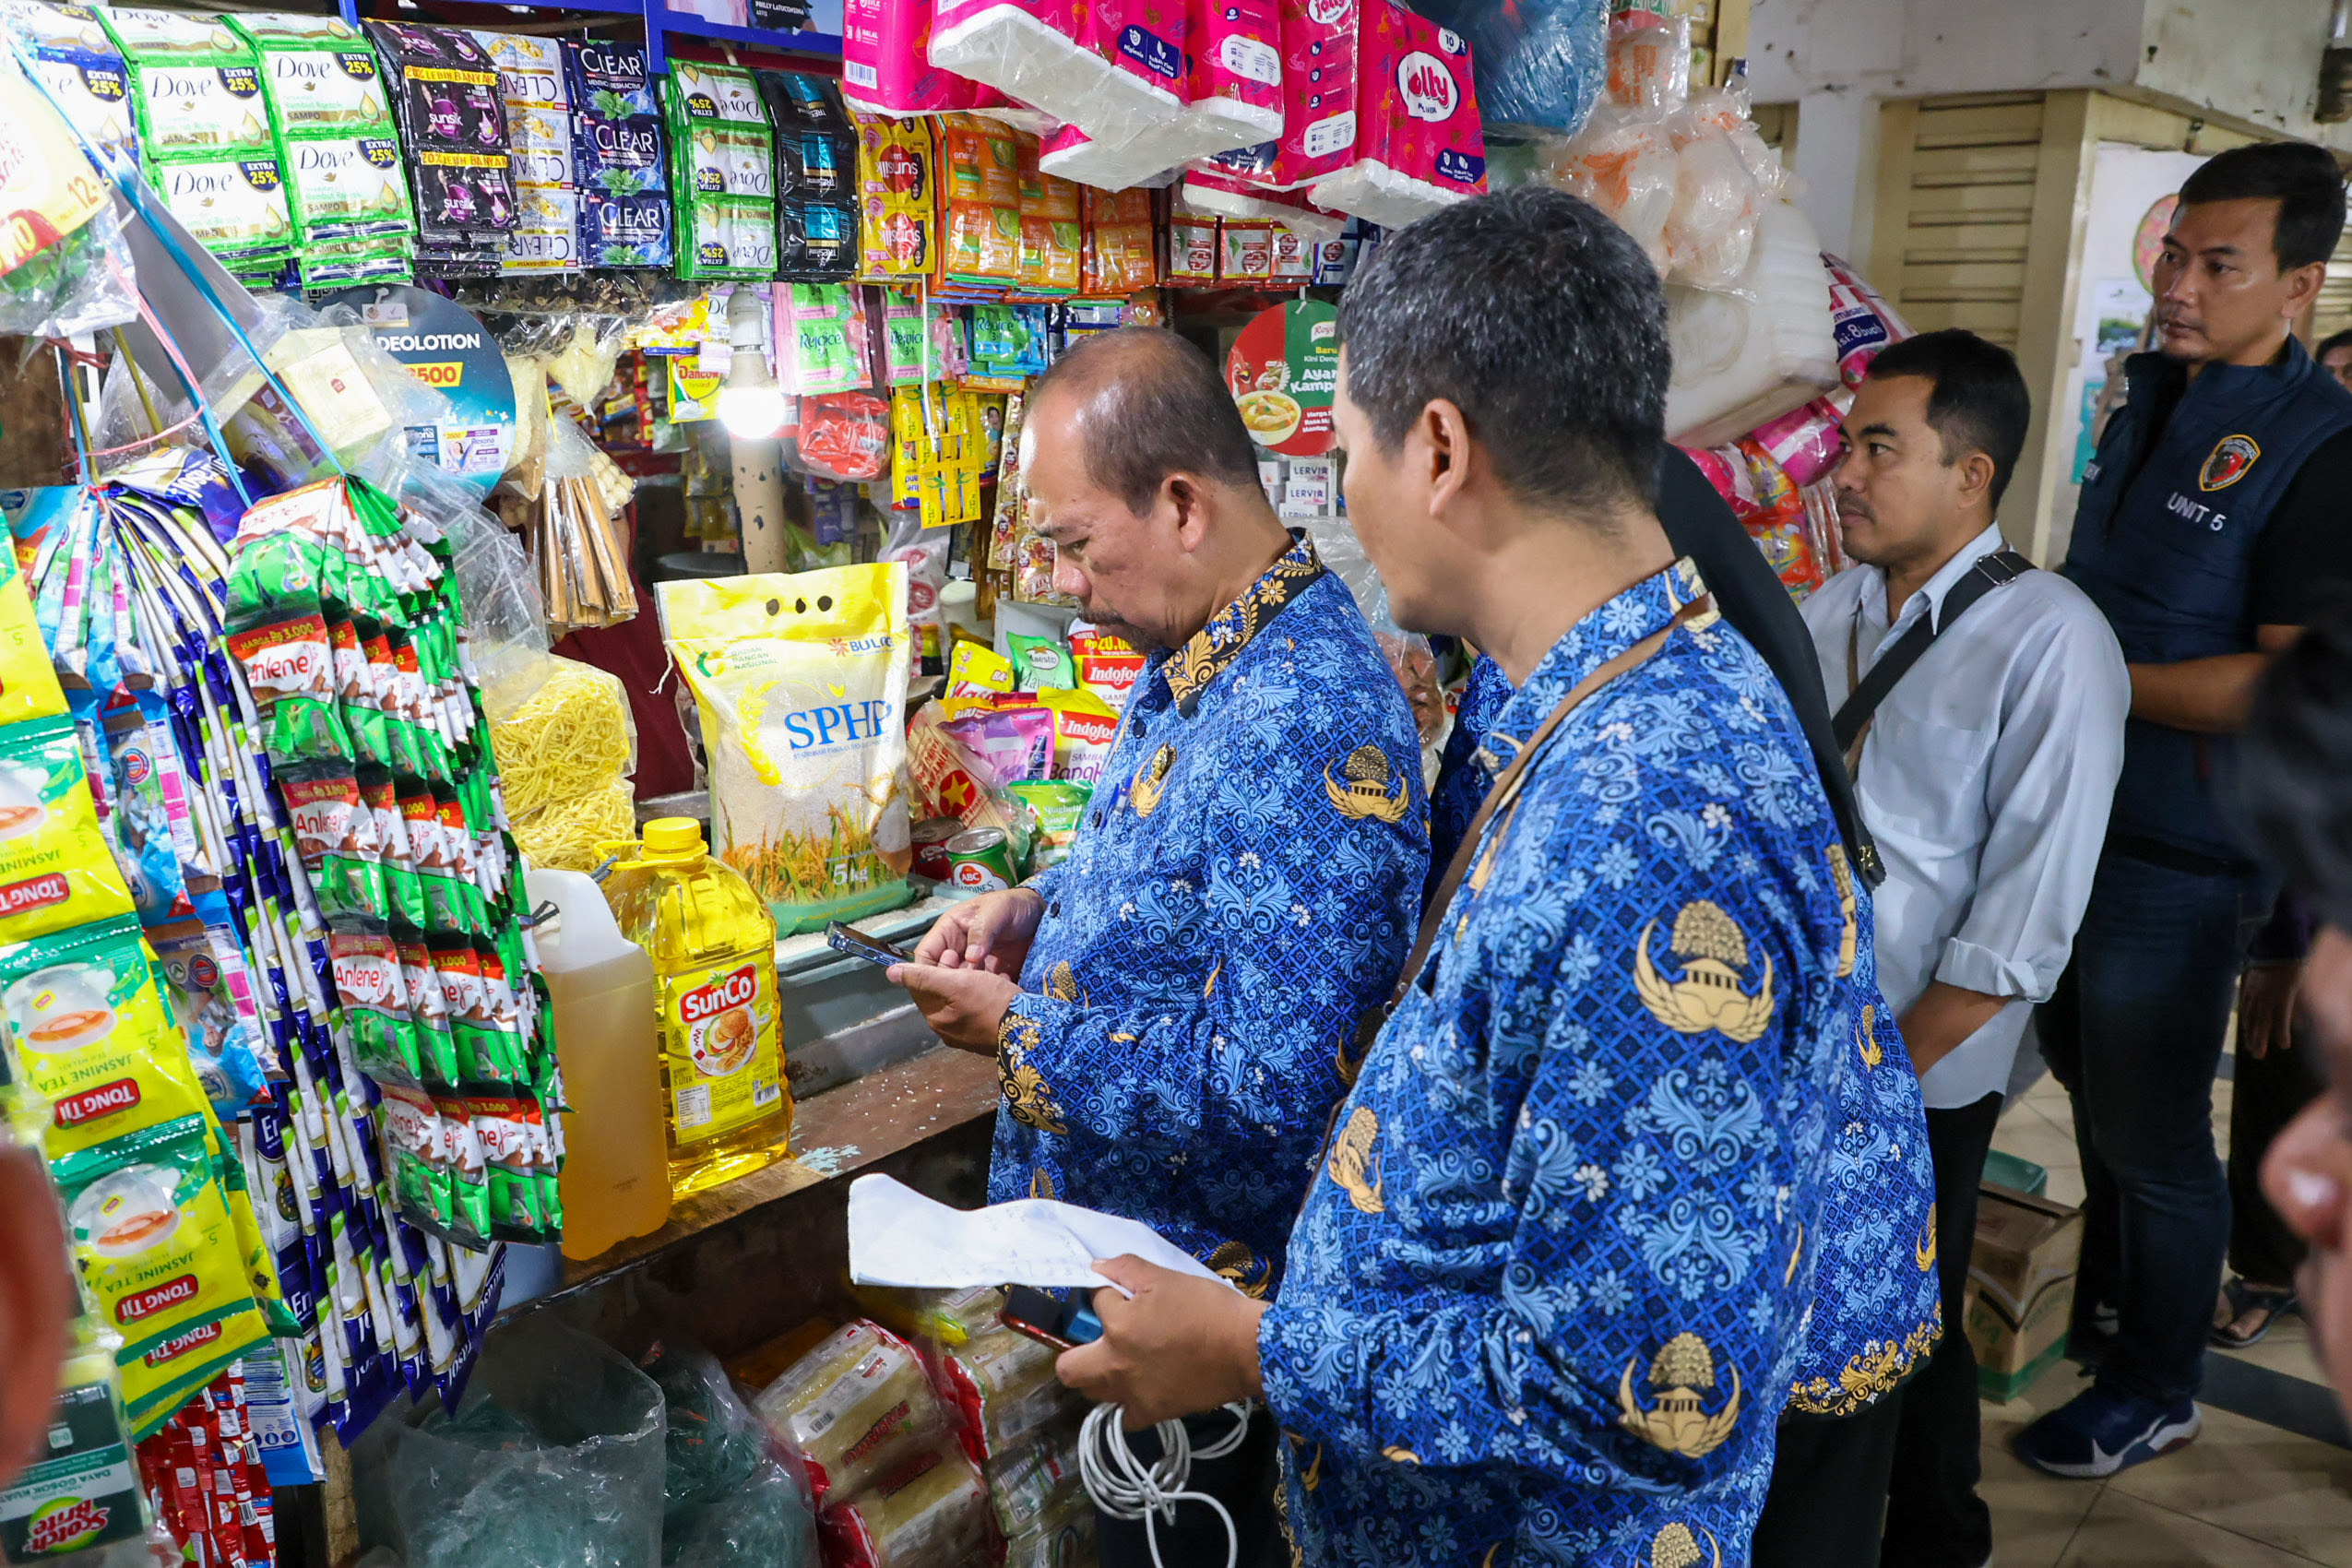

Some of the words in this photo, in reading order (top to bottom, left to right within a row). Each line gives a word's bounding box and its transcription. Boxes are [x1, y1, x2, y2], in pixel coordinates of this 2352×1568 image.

[113, 8, 170, 24] Dove
[274, 53, 330, 78] Dove
[343, 53, 369, 62] EXTRA
[580, 48, 643, 77] CLEAR
[223, 68, 255, 79] EXTRA
[346, 61, 373, 74] 25%
[87, 70, 121, 82] EXTRA
[426, 71, 452, 81] LEBIH
[454, 72, 494, 85] BANYAK
[89, 80, 123, 97] 25%
[149, 72, 212, 98] Dove
[226, 77, 257, 92] 25%
[1408, 65, 1450, 110] olly
[688, 99, 712, 109] 25%
[721, 100, 763, 121] Dove
[288, 112, 321, 120] SAMPO
[692, 108, 714, 117] EXTRA
[365, 140, 393, 148] EXTRA
[595, 124, 654, 152] CLEAR
[298, 145, 353, 170] Dove
[368, 148, 395, 162] 25%
[246, 161, 276, 172] EXTRA
[173, 169, 232, 196] Dove
[249, 171, 278, 184] 25%
[730, 171, 769, 196] Dove
[698, 184, 721, 193] EXTRA
[307, 203, 341, 213] SAMPO
[600, 201, 660, 228] CLEAR
[191, 229, 220, 240] AMPO
[701, 247, 725, 258] 25%
[698, 257, 725, 267] EXTRA
[976, 317, 1015, 333] Rejoice
[376, 333, 481, 351] DEOLOTION
[800, 332, 842, 349] Rejoice
[890, 330, 923, 345] Rejoic
[679, 365, 719, 380] Dancow
[1290, 381, 1336, 394] Kamp
[1306, 410, 1327, 419] Harga
[471, 436, 495, 445] Rexona
[1294, 466, 1329, 476] LERVIA
[1290, 489, 1324, 499] LERVIA
[2168, 492, 2210, 523] UNIT
[2210, 514, 2227, 531] 5
[284, 623, 315, 641] 3.000
[731, 647, 763, 658] BADAN
[731, 652, 770, 664] PANGAN
[734, 658, 778, 671] NASIONAL
[1089, 666, 1138, 685] Indofoo
[784, 699, 892, 751] SPHP
[1066, 720, 1116, 738] Indofoo
[1071, 753, 1105, 763] SAMBA
[923, 747, 950, 793] BINTANG
[1042, 803, 1084, 814] Spaghetti
[1042, 816, 1068, 825] Sauce
[833, 863, 848, 885] 5
[850, 866, 869, 884] kg
[961, 872, 980, 884] ABC
[9, 880, 65, 907] TONG
[335, 965, 379, 988] Anlene
[685, 975, 752, 1020] SunCo
[70, 1053, 133, 1083] JASMINE
[38, 1075, 67, 1092] TEA
[83, 1086, 136, 1113] TONG
[59, 1101, 85, 1121] TJI
[136, 1251, 195, 1283] JASMINE
[105, 1277, 133, 1294] TEA
[145, 1281, 194, 1309] TONG
[121, 1299, 146, 1317] TJI
[172, 1324, 217, 1350] TONG
[79, 1468, 112, 1482] DAYA
[32, 1478, 77, 1494] GOSOK
[27, 1506, 111, 1553] Scotch
